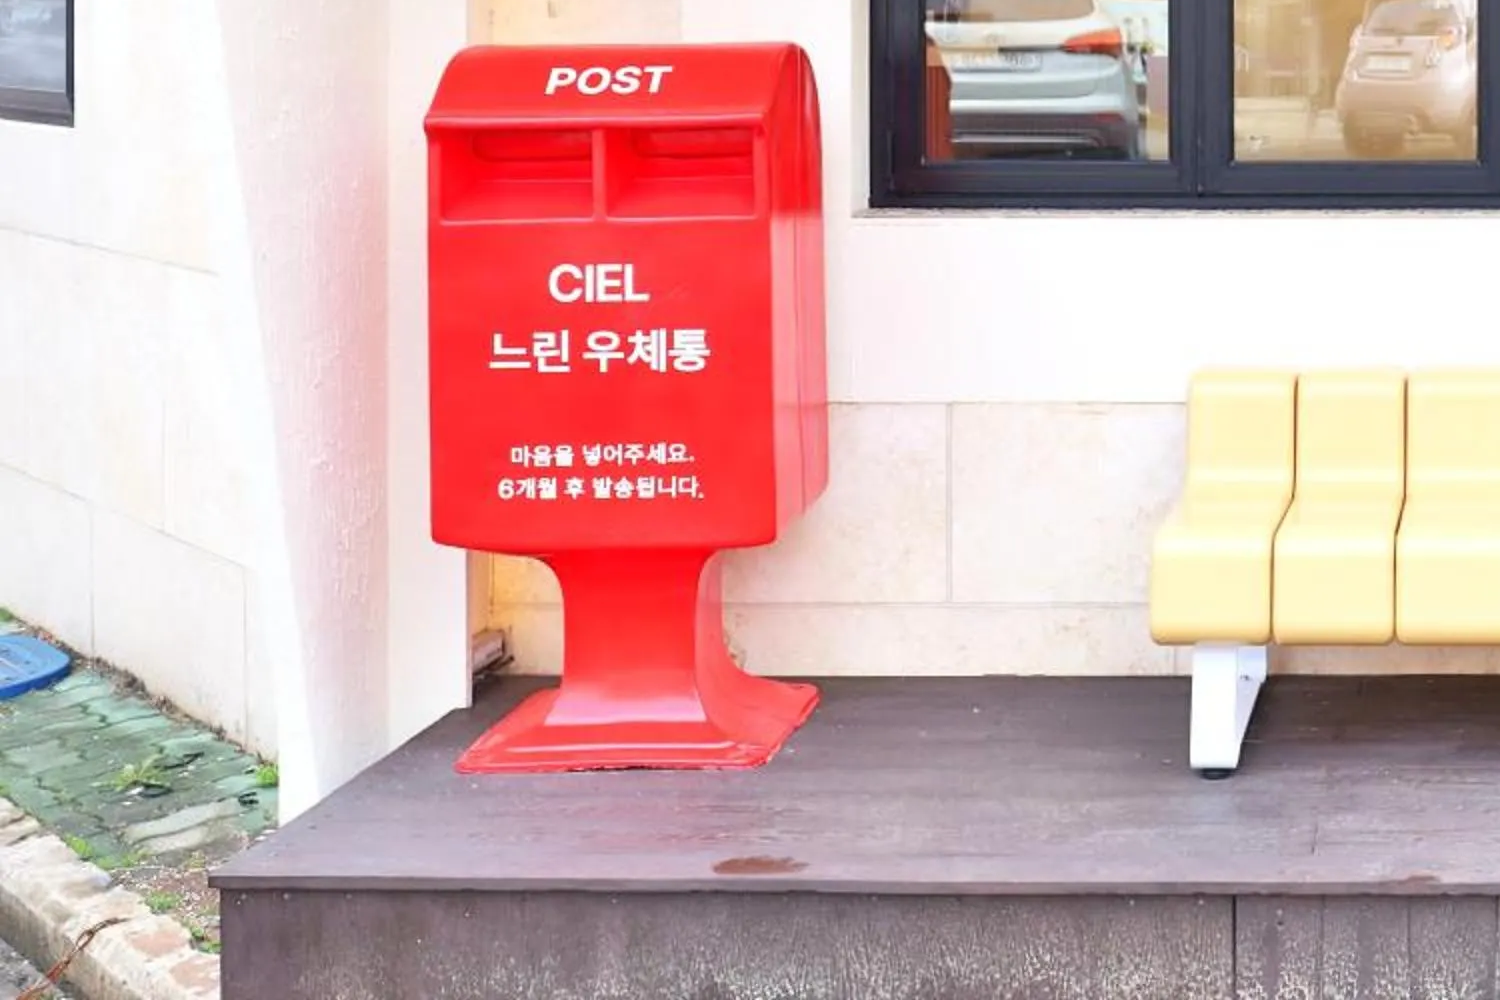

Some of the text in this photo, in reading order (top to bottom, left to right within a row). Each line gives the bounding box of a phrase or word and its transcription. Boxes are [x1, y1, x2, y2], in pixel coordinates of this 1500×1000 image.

[545, 65, 673, 95] POST
[548, 263, 650, 303] CIEL
[489, 327, 711, 373] 느린 우체통
[511, 442, 695, 468] 마음을 넣어주세요.
[497, 475, 704, 500] 6개월 후 발송됩니다.
